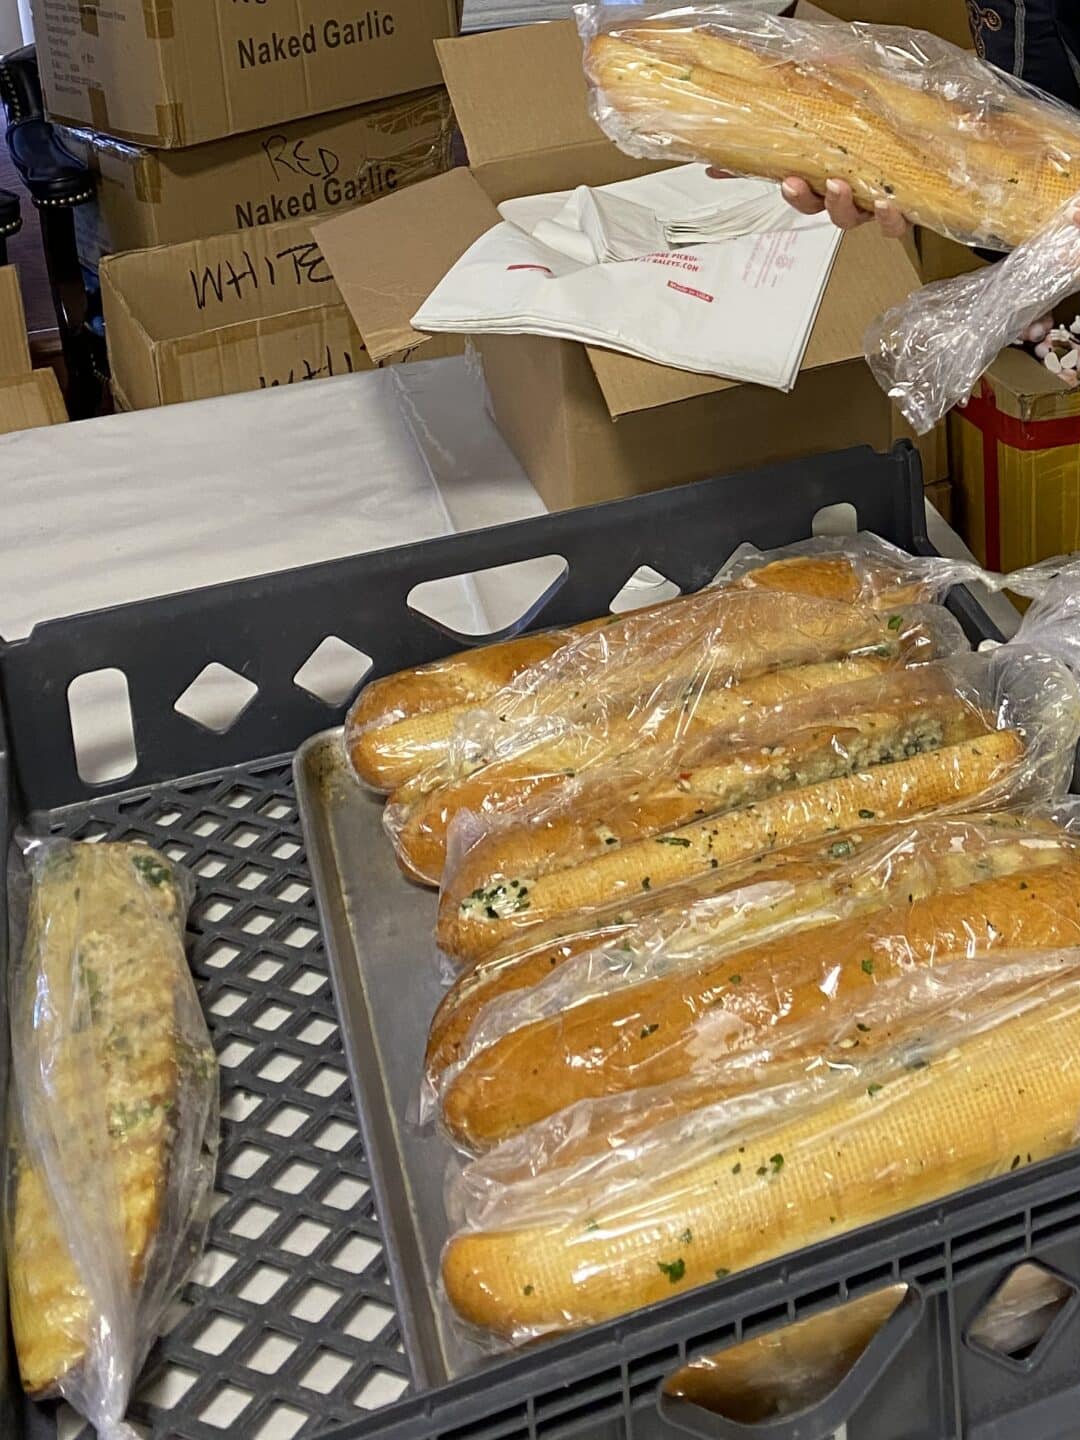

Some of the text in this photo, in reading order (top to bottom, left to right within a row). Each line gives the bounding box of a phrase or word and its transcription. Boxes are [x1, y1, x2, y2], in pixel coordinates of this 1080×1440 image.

[237, 10, 395, 69] Naked Garlic
[261, 134, 340, 182] RED
[234, 165, 398, 229] Naked Garlic
[189, 242, 334, 310] WHITE
